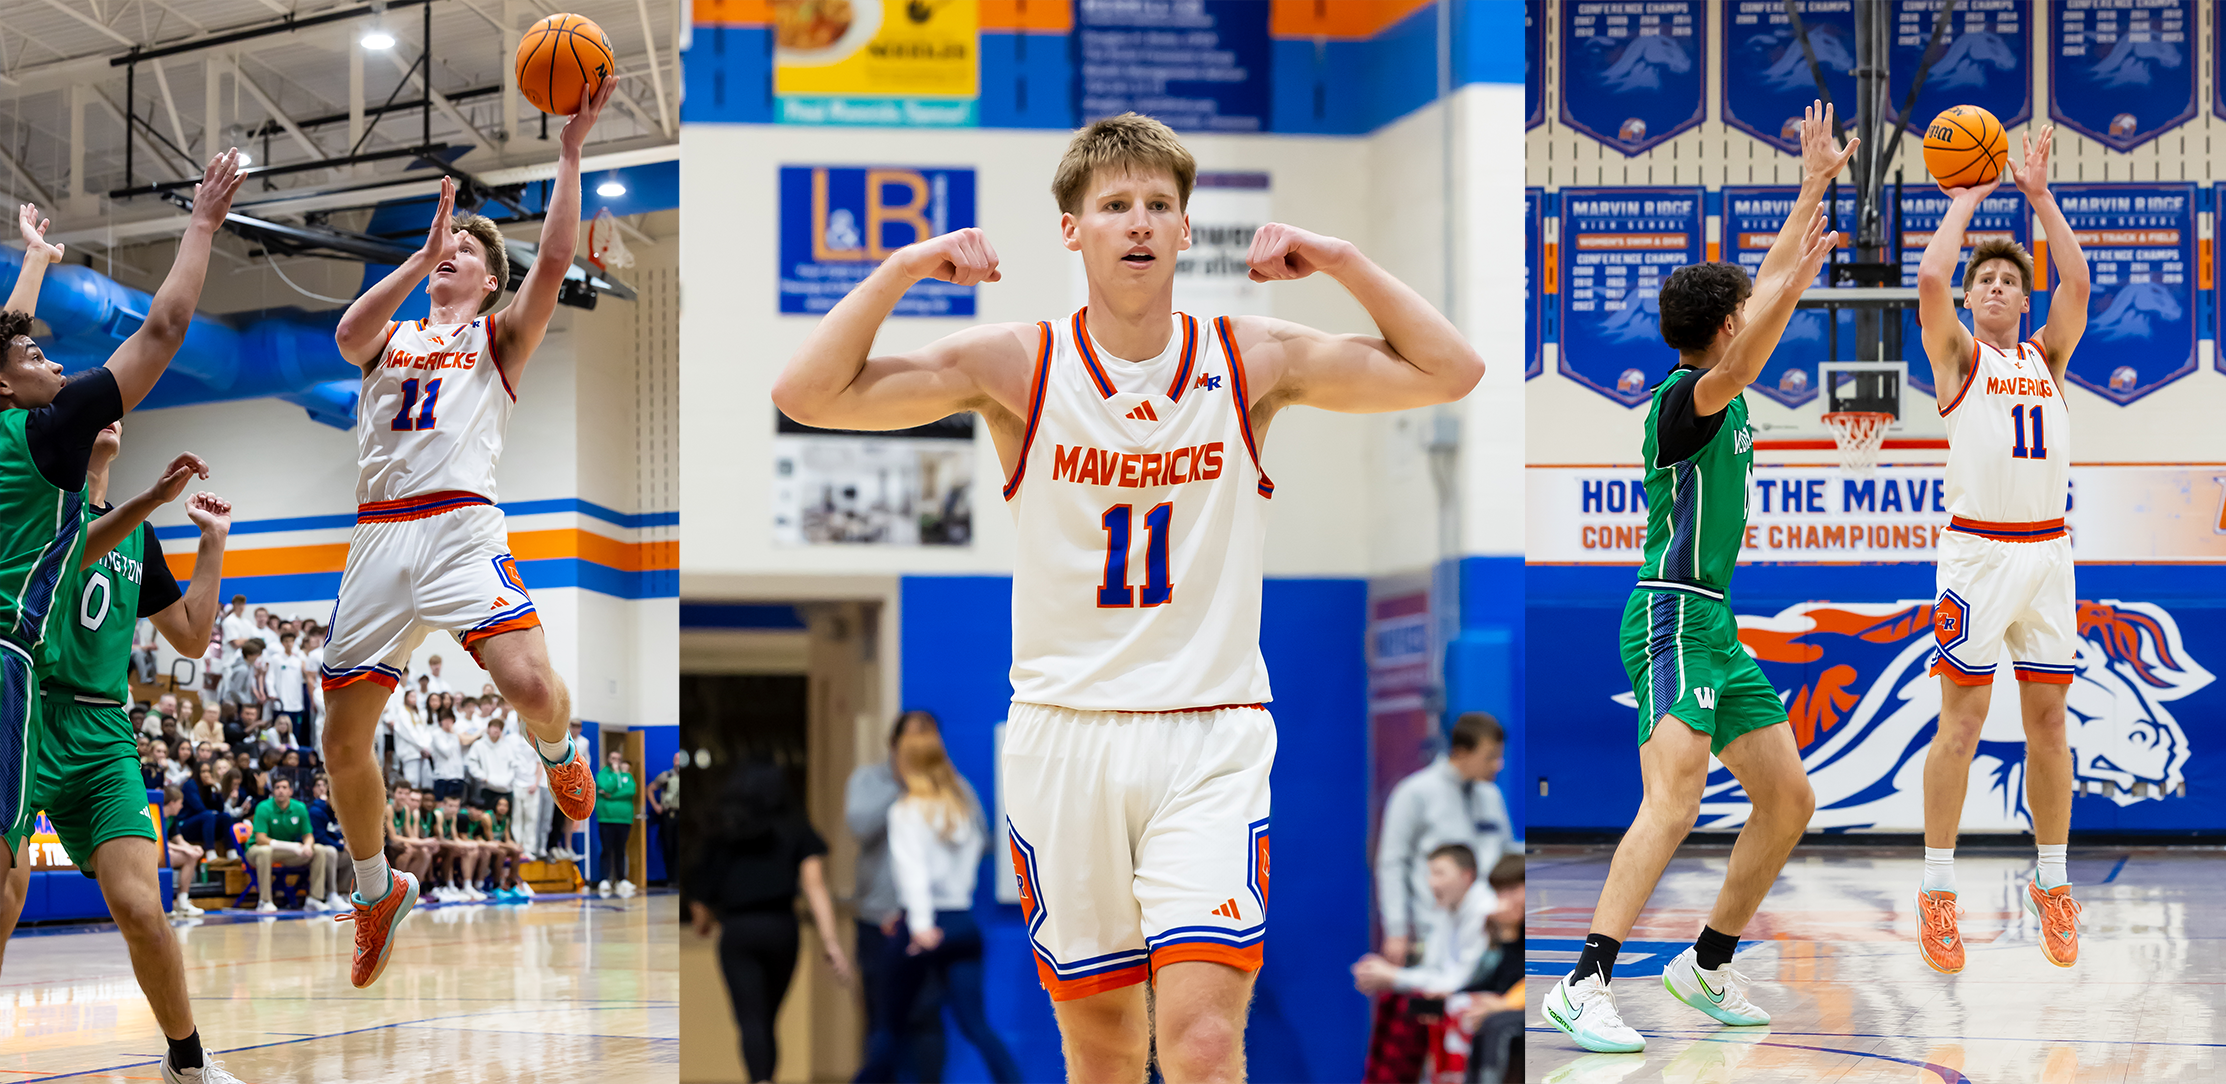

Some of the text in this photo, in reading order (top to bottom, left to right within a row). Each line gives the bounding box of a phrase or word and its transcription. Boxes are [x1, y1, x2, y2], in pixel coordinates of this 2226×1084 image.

[1740, 2, 1806, 13] CONFEREE
[1902, 0, 1969, 11] CONFERCE
[1573, 200, 1692, 216] MARVIN RIDGE
[1977, 198, 2019, 213] IDGE
[2062, 196, 2184, 212] MARVIN RIDGE
[1580, 220, 1684, 230] HIGH SCHOOL
[1576, 253, 1688, 264] CONFERENCE CHAMPS
[380, 348, 478, 371] MAVERICKS
[1194, 373, 1222, 391] MR
[391, 377, 443, 432] 11
[2011, 403, 2048, 460] 11
[1052, 441, 1224, 488] MAVERICKS
[1756, 480, 1826, 513] THE
[1096, 501, 1174, 608] 11
[79, 570, 110, 632] 0
[1693, 687, 1715, 710] W
[42, 842, 73, 866] THE
